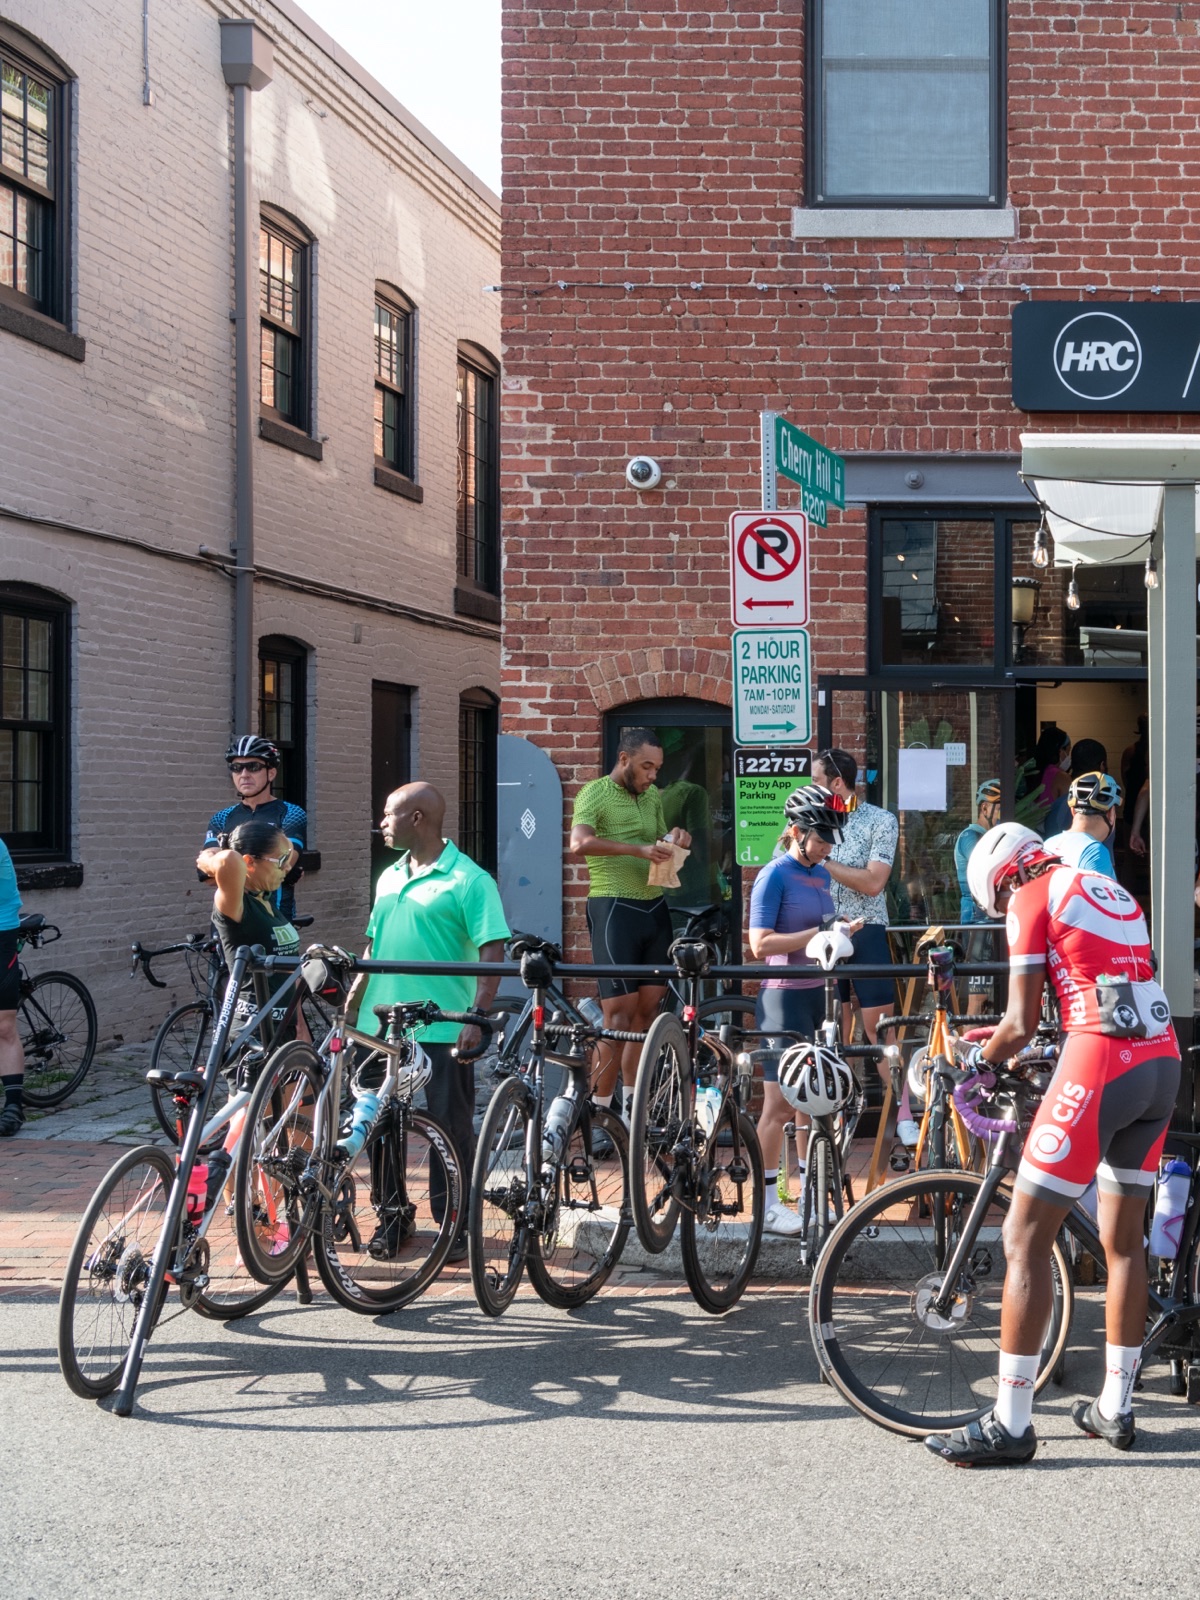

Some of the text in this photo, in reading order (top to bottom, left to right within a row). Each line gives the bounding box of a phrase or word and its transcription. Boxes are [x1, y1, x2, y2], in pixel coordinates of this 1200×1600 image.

[1060, 340, 1135, 372] HRC
[780, 426, 813, 487] Cherry
[815, 449, 831, 494] Hill
[804, 491, 826, 525] 3200
[741, 640, 800, 660] 2 HOUR
[741, 664, 802, 685] PARKING
[743, 687, 801, 701] 7AM-10PM
[749, 704, 796, 716] MONDAY-SATURDAY
[745, 757, 808, 773] 22757
[739, 780, 792, 790] Pay by App
[739, 791, 776, 801] Parking
[220, 980, 238, 1028] FEEDBACK
[1055, 1281, 1063, 1296] DT
